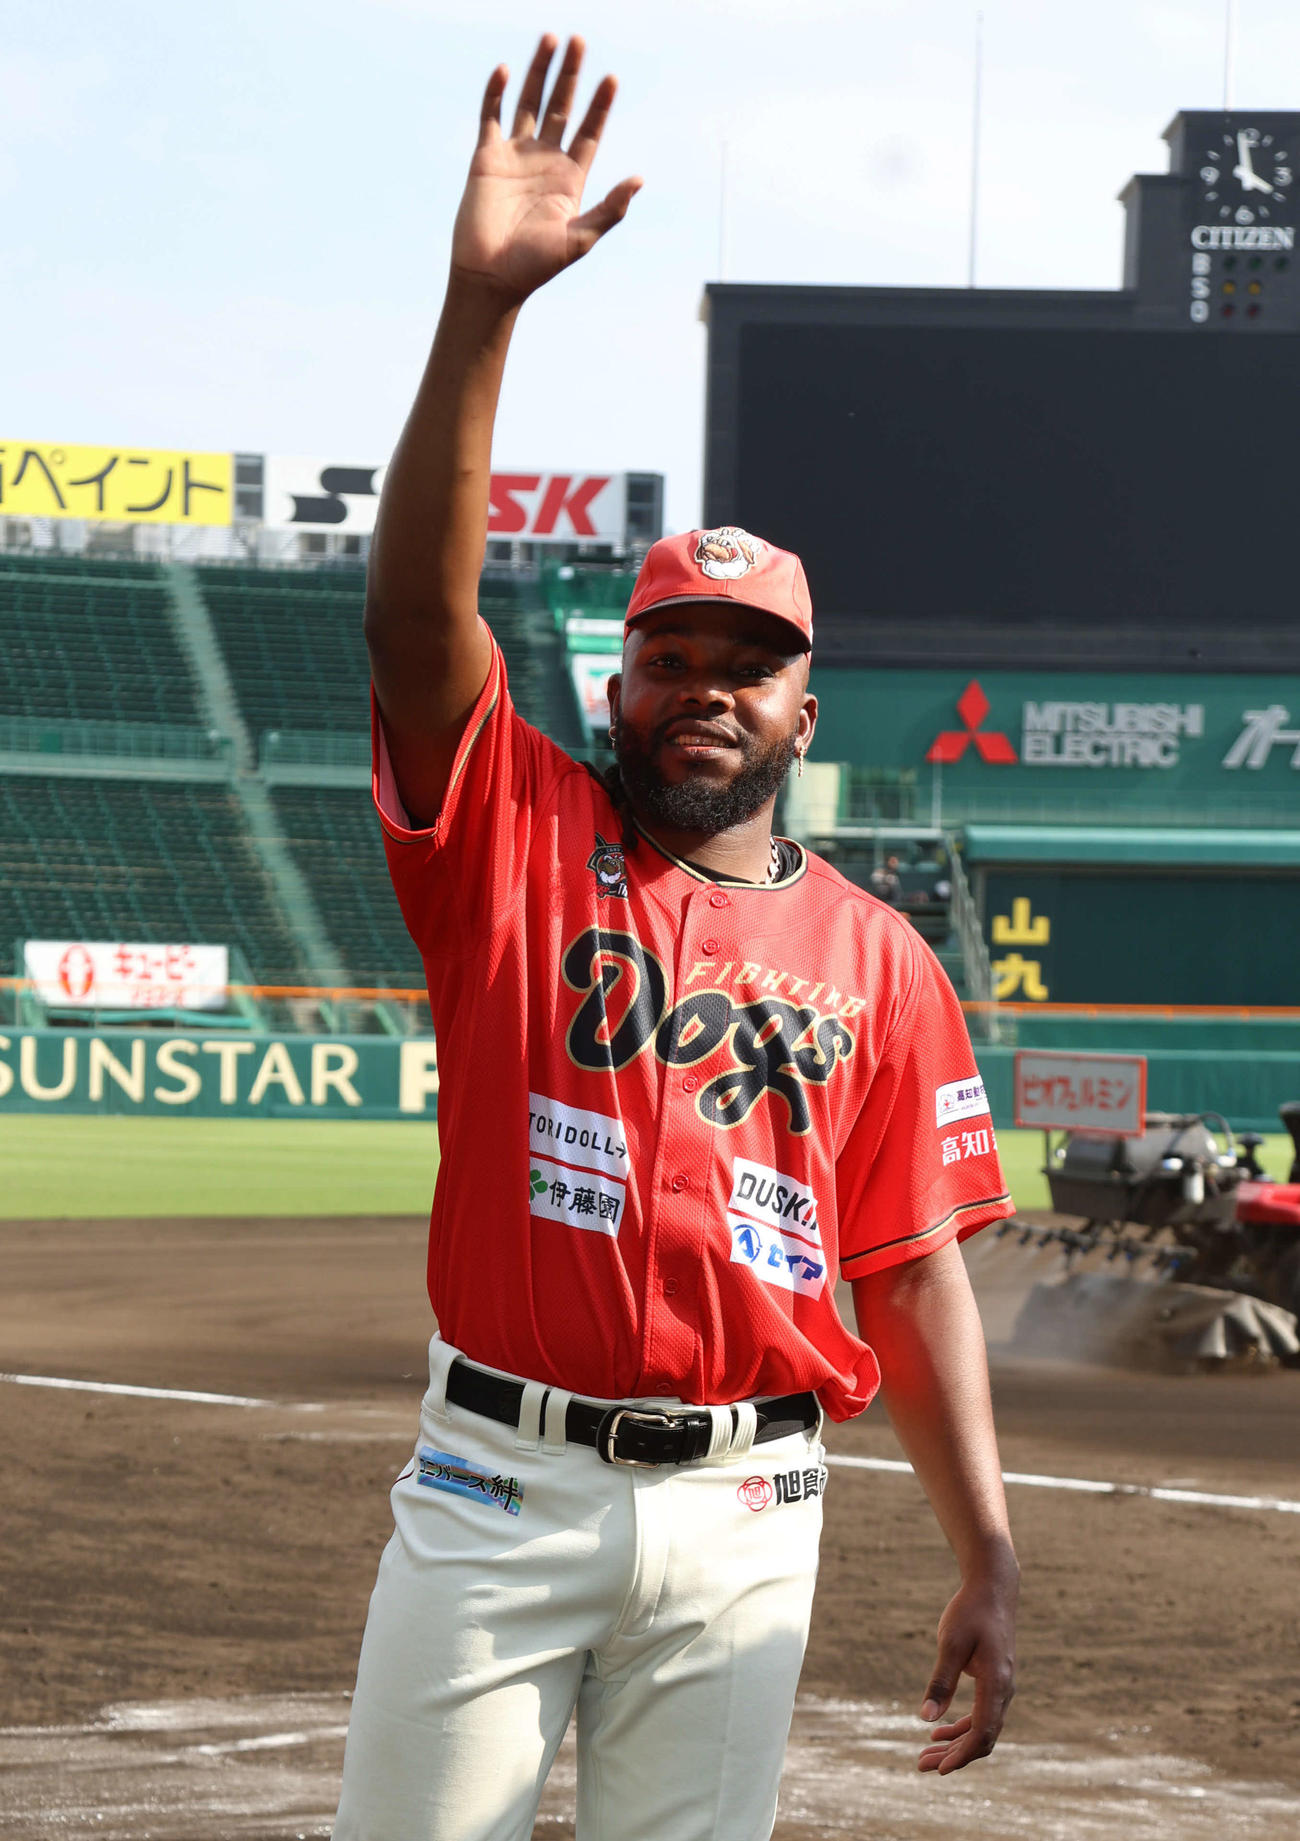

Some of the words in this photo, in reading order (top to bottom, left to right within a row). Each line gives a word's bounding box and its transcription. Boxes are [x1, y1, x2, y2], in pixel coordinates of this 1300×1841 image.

[1191, 225, 1295, 250] CITIZEN
[0, 446, 225, 517] ペイント
[1022, 701, 1205, 737] MITSUBISHI
[1022, 733, 1180, 767] ELECTRIC
[684, 961, 866, 1018] FIGHTING
[561, 924, 855, 1136] Dogs
[529, 1112, 615, 1155] TORIDOLL
[549, 1179, 620, 1224] 伊藤園
